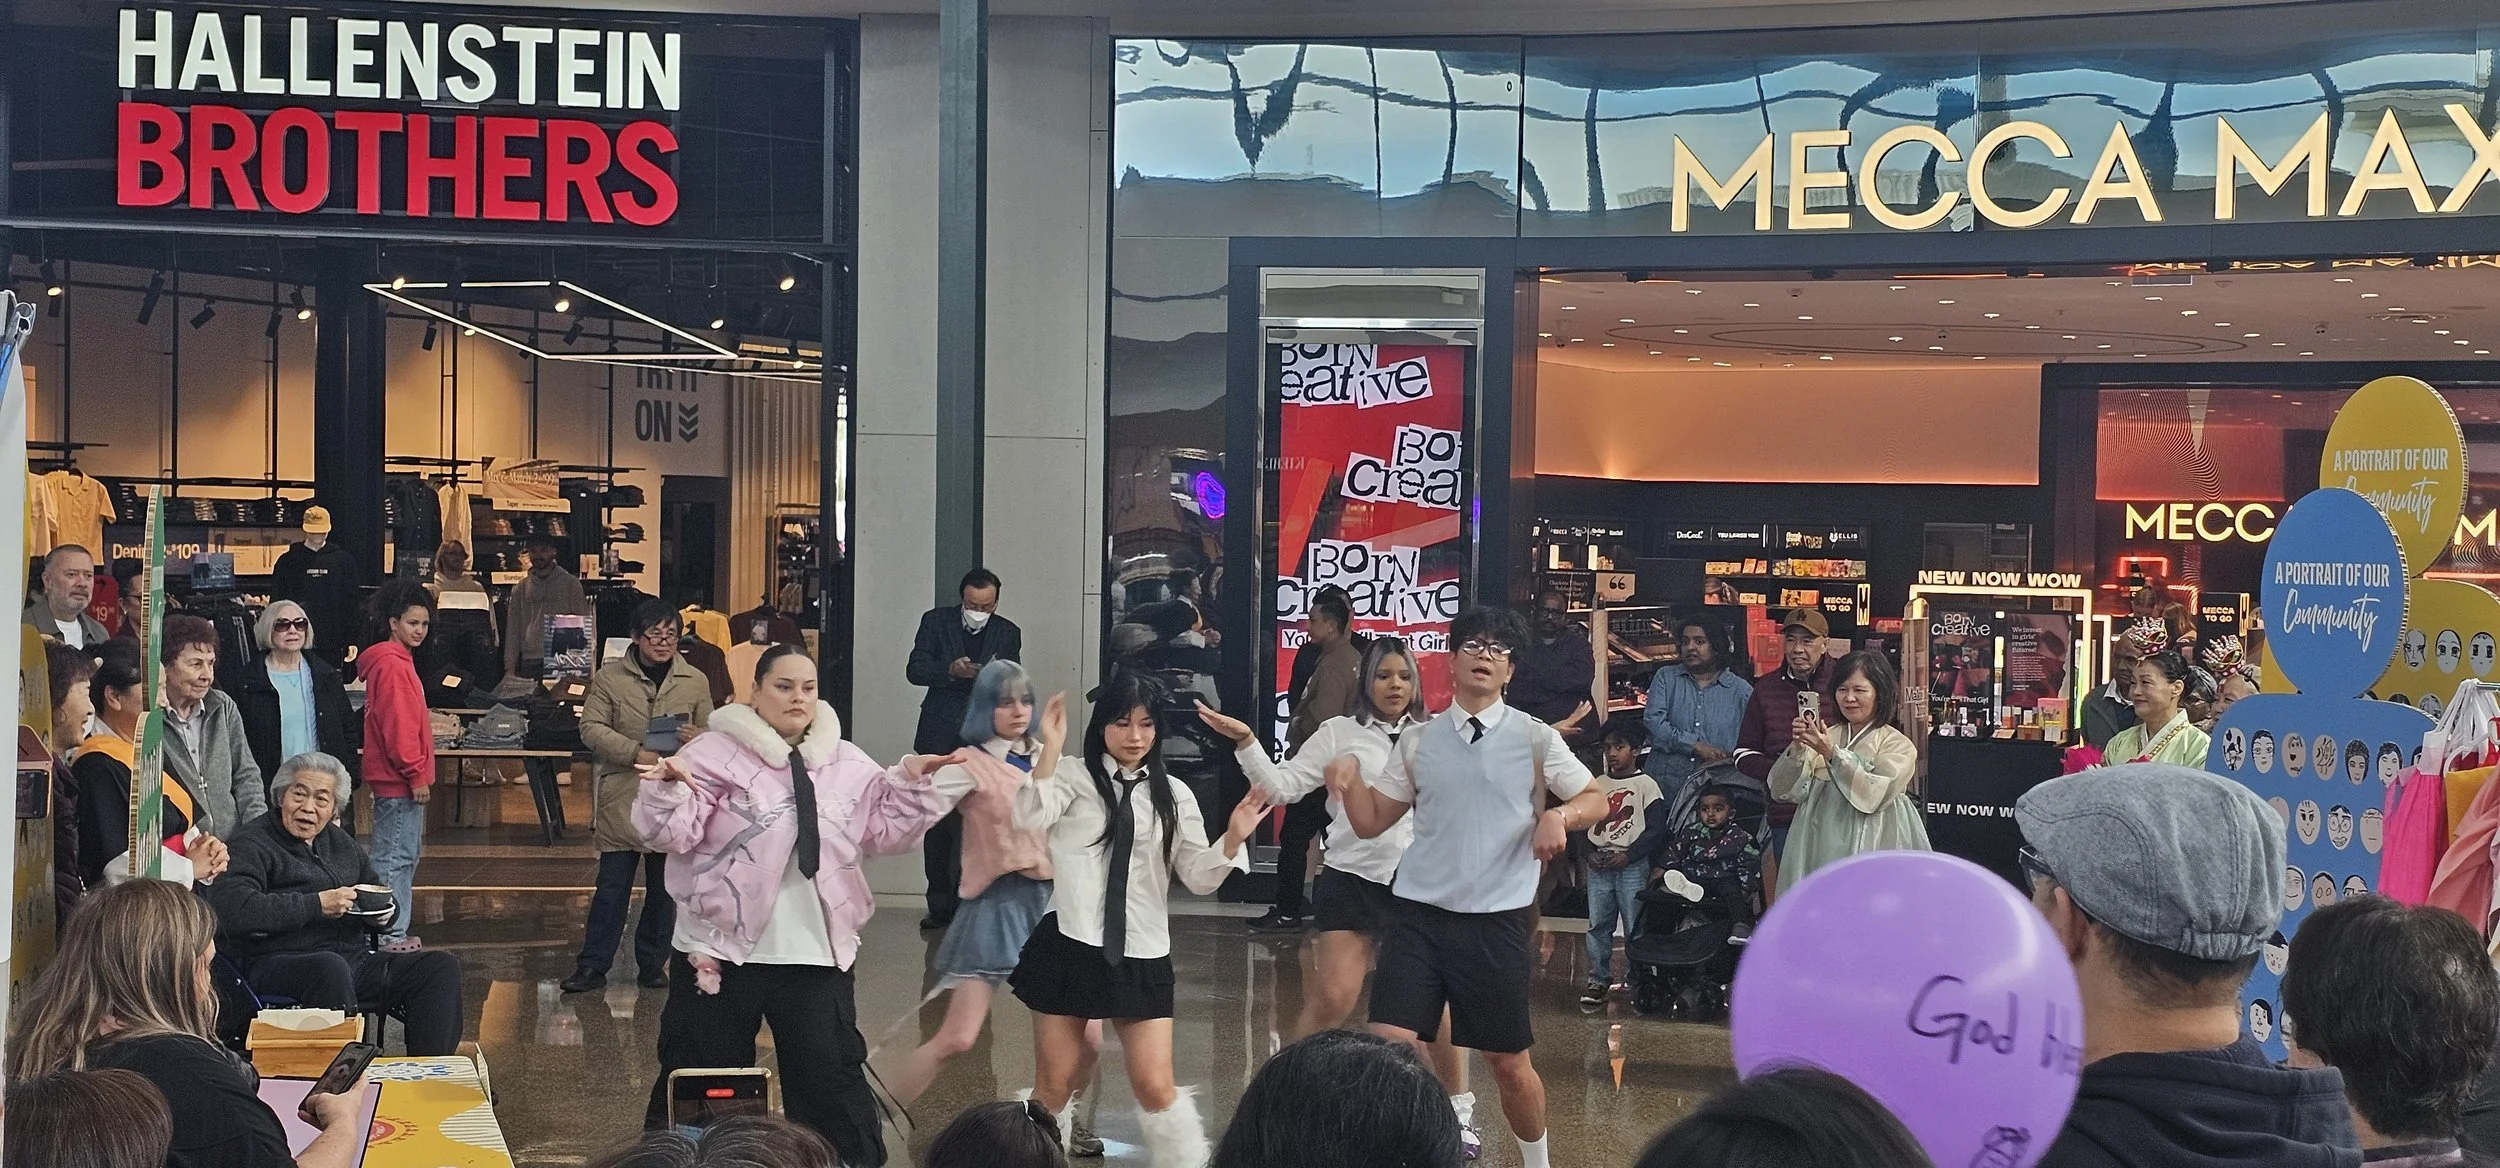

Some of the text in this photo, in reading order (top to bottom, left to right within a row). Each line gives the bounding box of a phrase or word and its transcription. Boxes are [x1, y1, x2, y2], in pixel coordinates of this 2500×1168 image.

[118, 8, 681, 111] HALLENSTEIN
[117, 101, 680, 226] BROTHERS
[1671, 103, 2500, 233] MECCA MAX
[635, 399, 672, 442] ON
[2333, 448, 2449, 472] A PORTRAIT OF OUR
[2125, 503, 2275, 543] MECC
[2346, 475, 2439, 534] mmunity
[1918, 570, 2081, 588] NEW NOW WOW
[2275, 562, 2390, 587] A PORTRAIT OF OUR
[1276, 579, 1459, 623] Crative
[1823, 597, 1853, 605] MECCA
[2202, 607, 2235, 615] MECCA
[2283, 588, 2381, 653] Community
[1927, 802, 1951, 814] EW
[1956, 804, 1994, 817] NOW
[1907, 974, 2019, 1064] God
